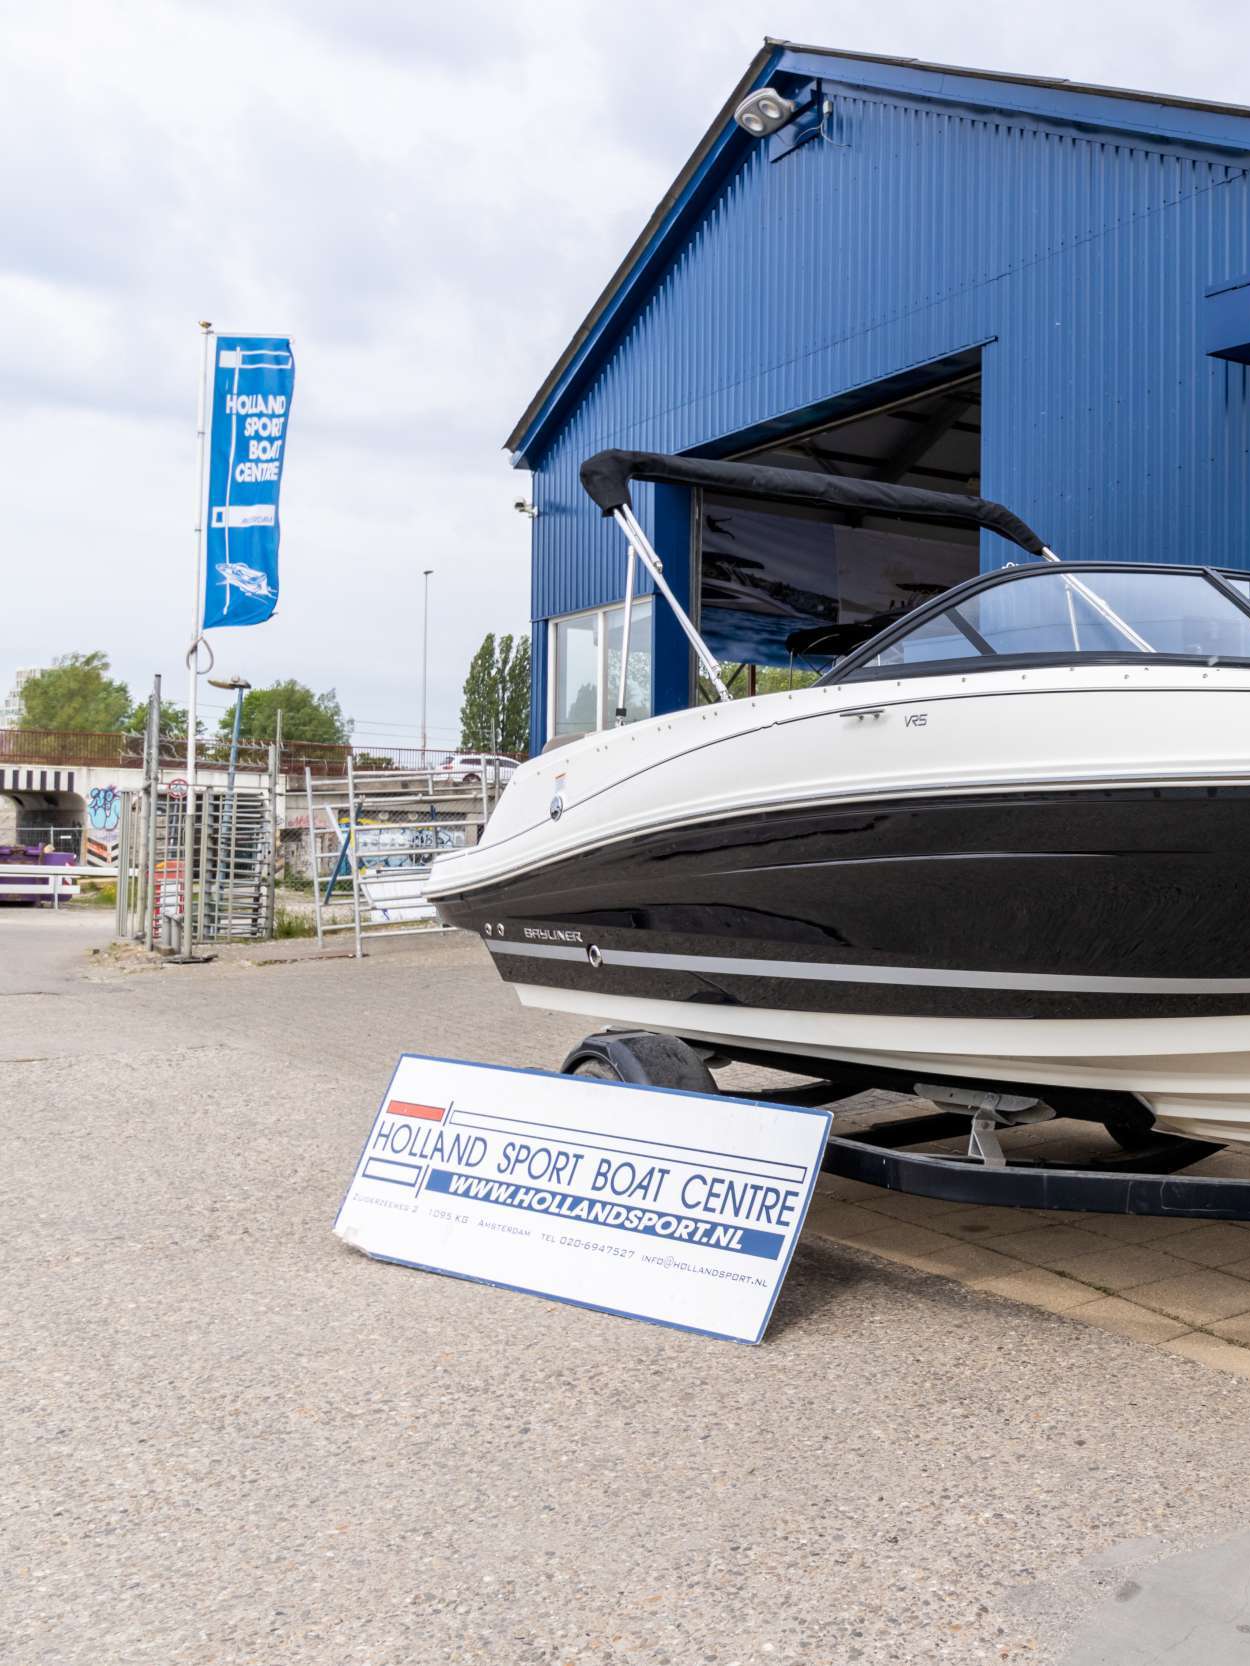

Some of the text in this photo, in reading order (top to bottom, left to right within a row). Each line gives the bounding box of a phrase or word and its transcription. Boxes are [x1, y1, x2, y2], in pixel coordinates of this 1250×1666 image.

[226, 394, 286, 415] HOLLAND
[244, 416, 285, 437] SPORT
[249, 440, 282, 460] BOAT
[235, 461, 280, 482] CENTRE
[524, 927, 583, 943] BAYLINER
[373, 1120, 800, 1227] HOLLAND SPORT BOAT CENTRE
[449, 1174, 745, 1250] WWW.HOLLANDSPORT.NL
[428, 1208, 453, 1222] 1095
[455, 1215, 469, 1225] KG
[477, 1218, 531, 1237] AMSTERDAM
[541, 1232, 556, 1244] TEL
[559, 1236, 636, 1260] 020-6947527
[641, 1253, 769, 1288] INFO@HOLLANDSPORT.NL
